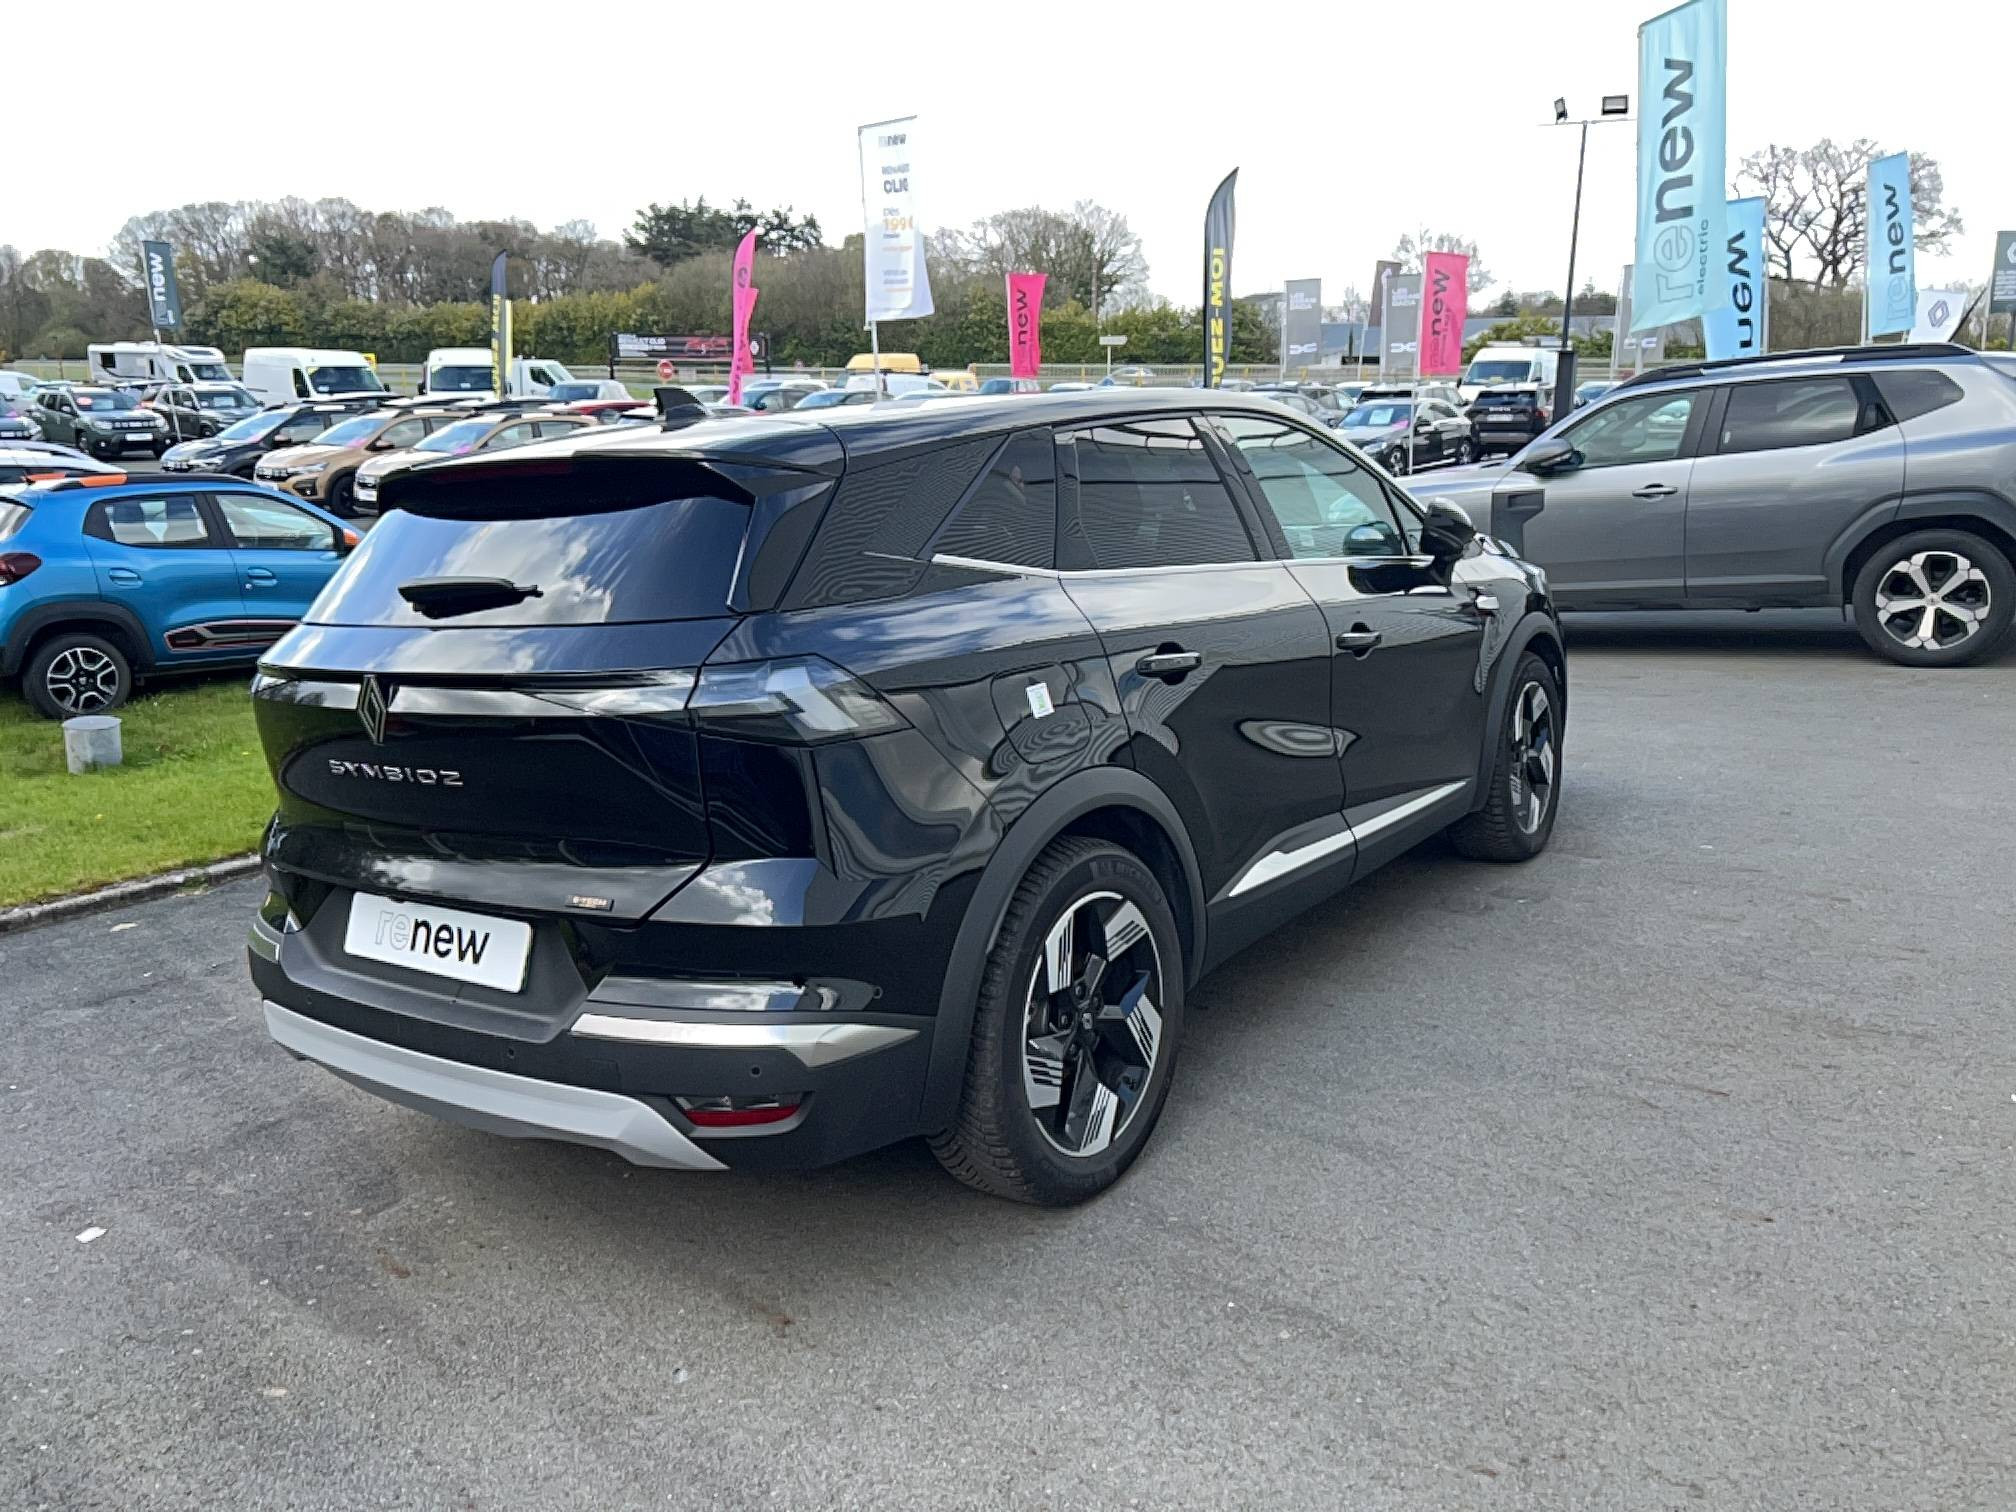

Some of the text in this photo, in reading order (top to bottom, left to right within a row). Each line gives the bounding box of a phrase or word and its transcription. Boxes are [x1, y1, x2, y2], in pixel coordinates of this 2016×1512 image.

[1653, 58, 1695, 303] renew
[1697, 219, 1709, 295] electric
[1883, 183, 1908, 321] renew
[1016, 288, 1028, 373] new
[1209, 248, 1224, 388] UEZ-MOI
[328, 759, 464, 786] SYMBIOZ
[375, 910, 491, 965] renew
